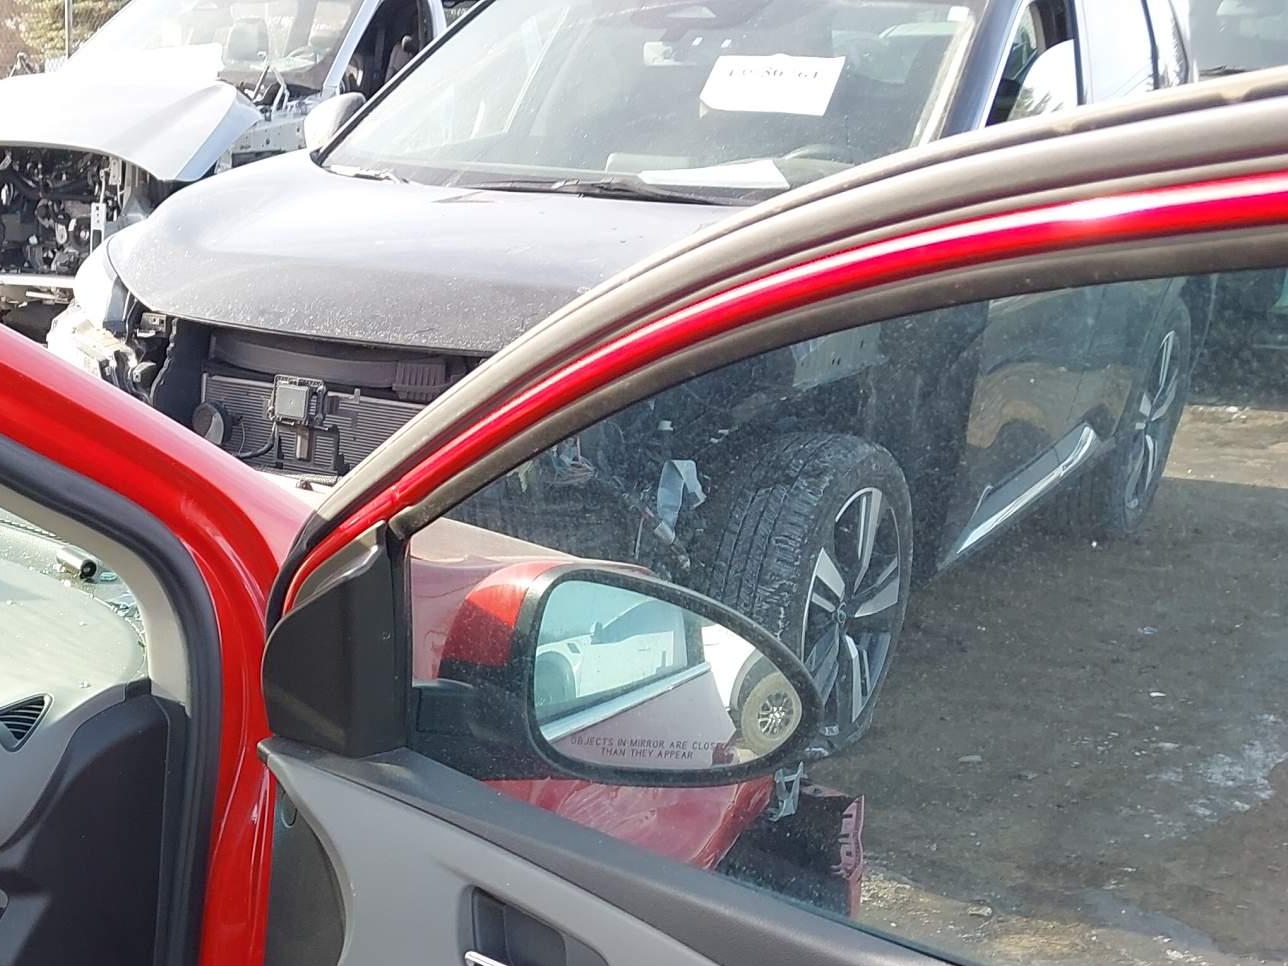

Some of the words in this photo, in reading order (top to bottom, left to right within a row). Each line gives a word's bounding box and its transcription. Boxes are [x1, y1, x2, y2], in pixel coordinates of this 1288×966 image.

[570, 735, 614, 746] OBJECTS
[617, 738, 627, 747] IN
[630, 738, 665, 749] MIRROR
[669, 740, 688, 750] ARE
[601, 746, 626, 757] THAN
[631, 748, 654, 758] THEY
[657, 749, 694, 760] APPEAR
